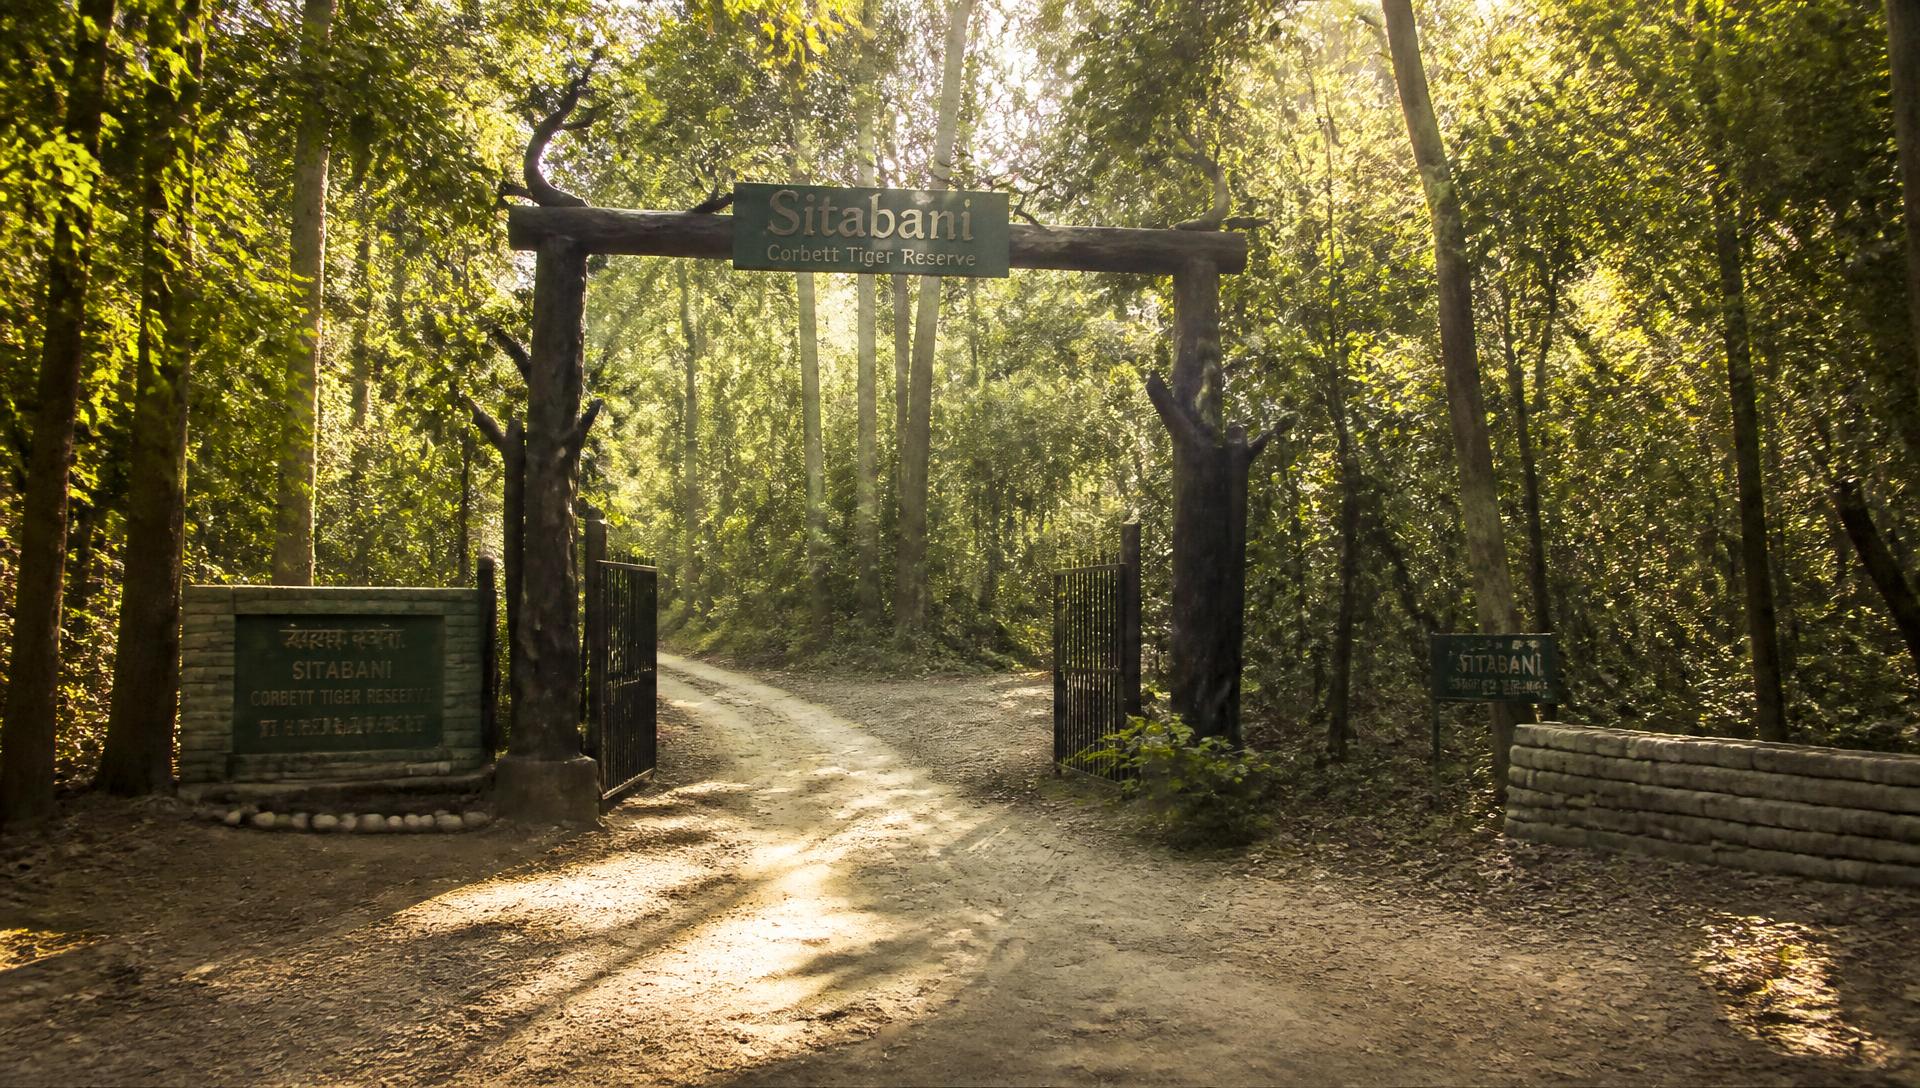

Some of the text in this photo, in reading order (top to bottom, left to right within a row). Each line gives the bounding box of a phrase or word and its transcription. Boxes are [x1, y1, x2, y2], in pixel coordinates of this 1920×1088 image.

[767, 189, 974, 241] Sitabani
[767, 244, 976, 267] Corbett Tiger Reserve
[292, 660, 392, 680] SITABANI
[251, 689, 315, 706] CORBETT
[320, 688, 361, 705] TIGER
